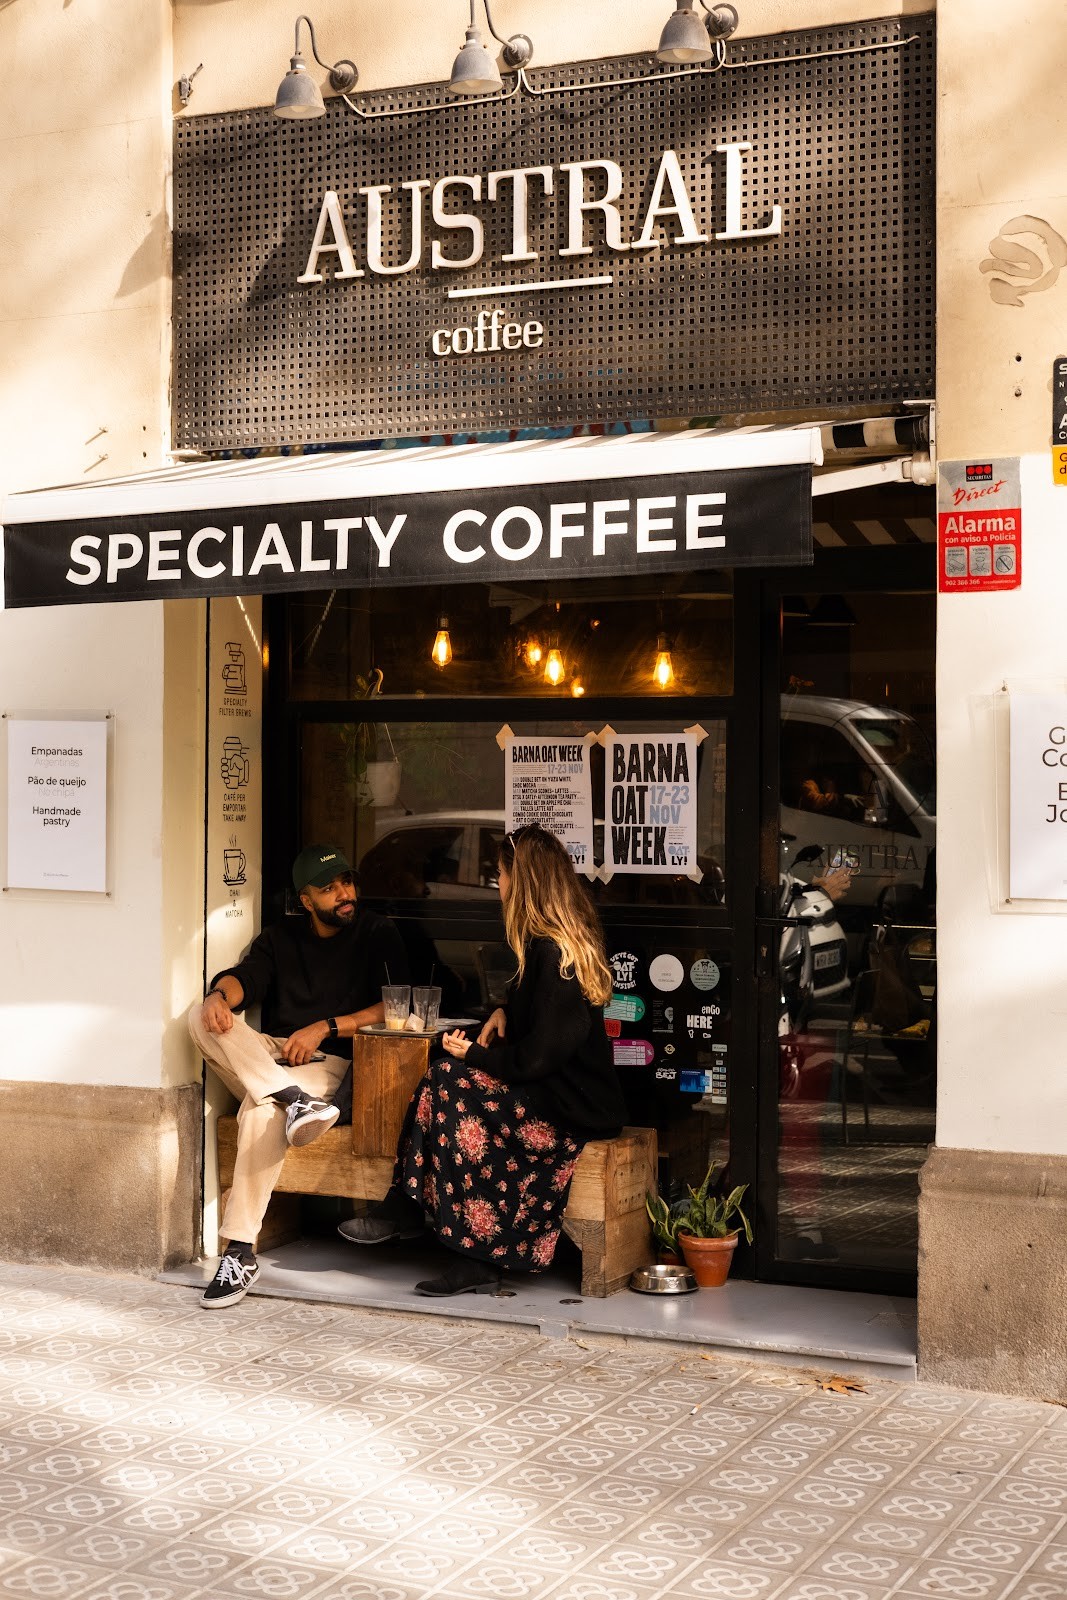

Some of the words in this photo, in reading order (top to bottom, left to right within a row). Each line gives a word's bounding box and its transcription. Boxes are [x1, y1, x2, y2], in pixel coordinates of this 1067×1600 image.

[296, 141, 782, 284] AUSTRAL
[432, 309, 544, 356] coffee
[952, 480, 1007, 506] Direct
[945, 515, 1016, 534] Alarma
[66, 513, 408, 587] SPECIALTY
[442, 492, 728, 565] COFFEE
[961, 535, 981, 543] aviso
[990, 532, 1016, 541] Policía
[223, 698, 247, 706] SPECIALTY
[219, 708, 234, 717] FILTER
[236, 709, 252, 717] BREWS
[31, 747, 83, 758] Empanadas
[513, 745, 541, 763] BARNA
[542, 745, 558, 763] OAT
[558, 744, 584, 762] WEEK
[34, 758, 80, 768] Argentinas
[612, 743, 690, 783] BARNA
[548, 764, 567, 774] 17-23
[568, 764, 584, 773] NOV
[27, 776, 44, 786] Pão
[46, 776, 58, 786] de
[59, 777, 87, 788] queijo
[223, 792, 236, 801] CAFÉ
[236, 794, 246, 802] PER
[222, 804, 247, 812] EMPORTAR
[611, 785, 648, 825] OAT
[649, 785, 690, 805] 17-23
[32, 806, 81, 816] Handmade
[650, 805, 681, 824] NOV
[43, 817, 70, 827] pastry
[235, 814, 247, 822] AWAY
[611, 826, 667, 866] WEEK
[229, 889, 241, 897] CHAI
[225, 909, 244, 918] MATCHA
[627, 953, 639, 963] GOT
[616, 971, 633, 981] LY!
[686, 1014, 713, 1030] HERE
